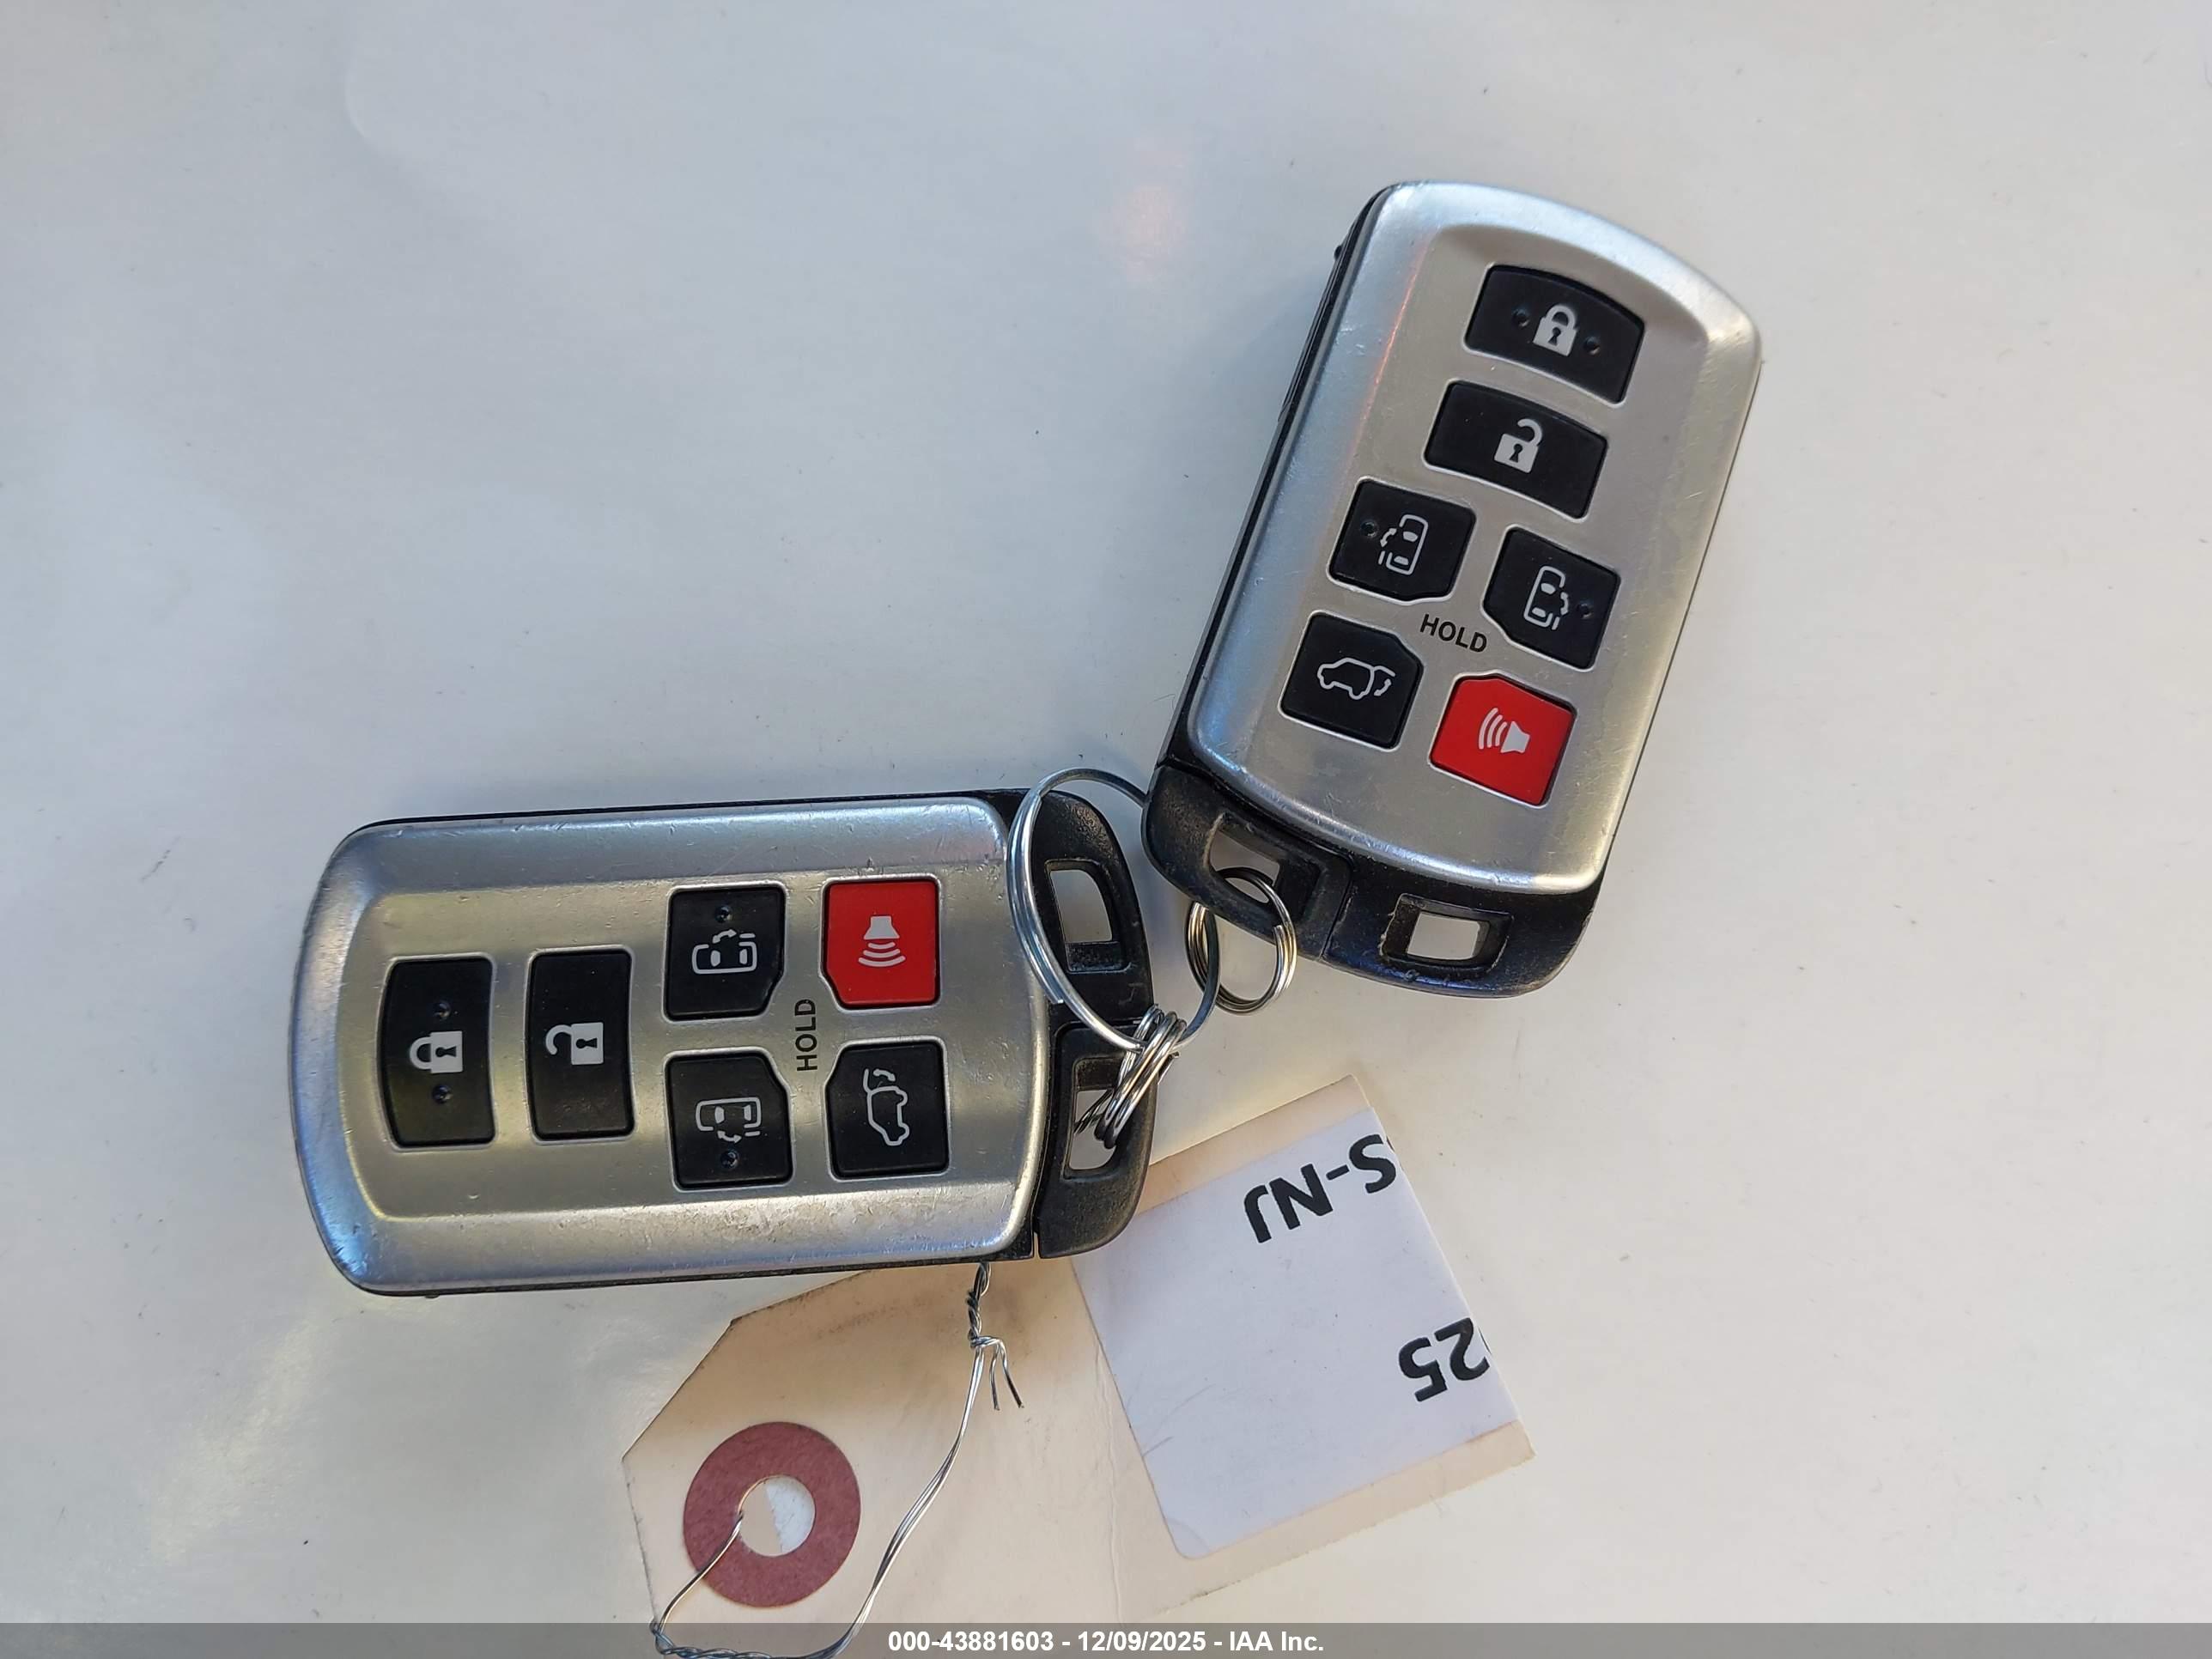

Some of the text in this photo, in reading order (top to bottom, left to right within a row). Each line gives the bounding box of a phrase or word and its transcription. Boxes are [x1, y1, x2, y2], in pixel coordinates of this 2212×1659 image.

[1419, 613, 1487, 653] HOLD
[793, 999, 818, 1072] HOLD
[1243, 1133, 1397, 1243] S-NJ
[1398, 1317, 1492, 1402] 25
